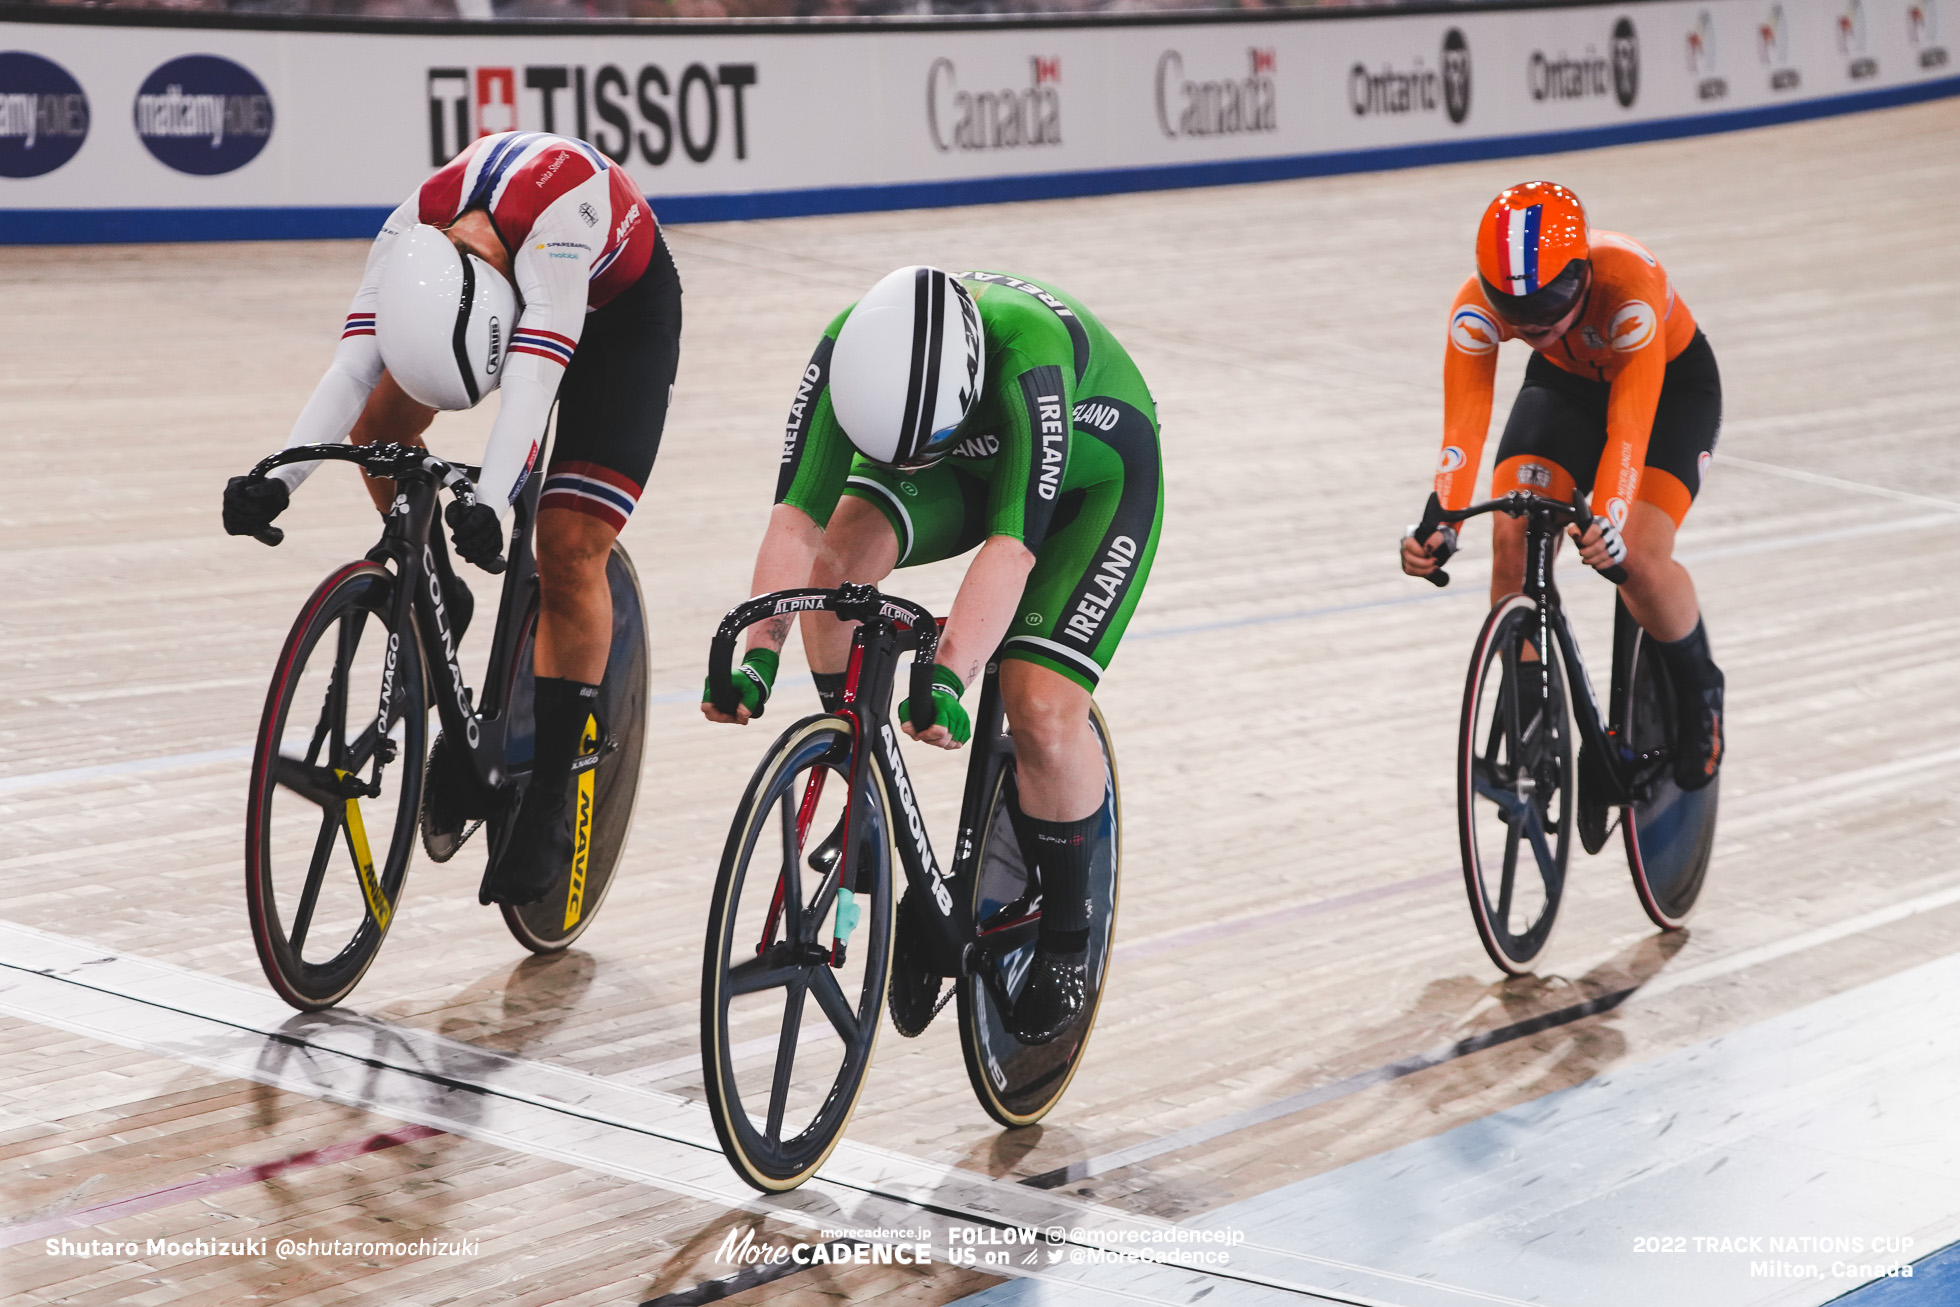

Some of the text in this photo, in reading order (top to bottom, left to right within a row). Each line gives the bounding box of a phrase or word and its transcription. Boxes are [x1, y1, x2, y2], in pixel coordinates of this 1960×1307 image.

[525, 63, 757, 166] TISSOT
[926, 56, 1062, 152] Canada
[1154, 47, 1277, 138] Canada
[1349, 56, 1437, 117] Ontario
[1528, 44, 1609, 104] Ontario
[535, 170, 554, 188] Anita
[780, 363, 822, 463] IRELAND
[1037, 395, 1063, 500] IRELAND
[1072, 403, 1120, 431] ELAND
[773, 597, 825, 615] ALPINA
[1064, 535, 1137, 643] IRELAND
[378, 632, 399, 734] OLNAGO
[423, 544, 479, 749] COLNAGO
[568, 790, 590, 914] MAVIC
[880, 723, 953, 917] ARGON 18
